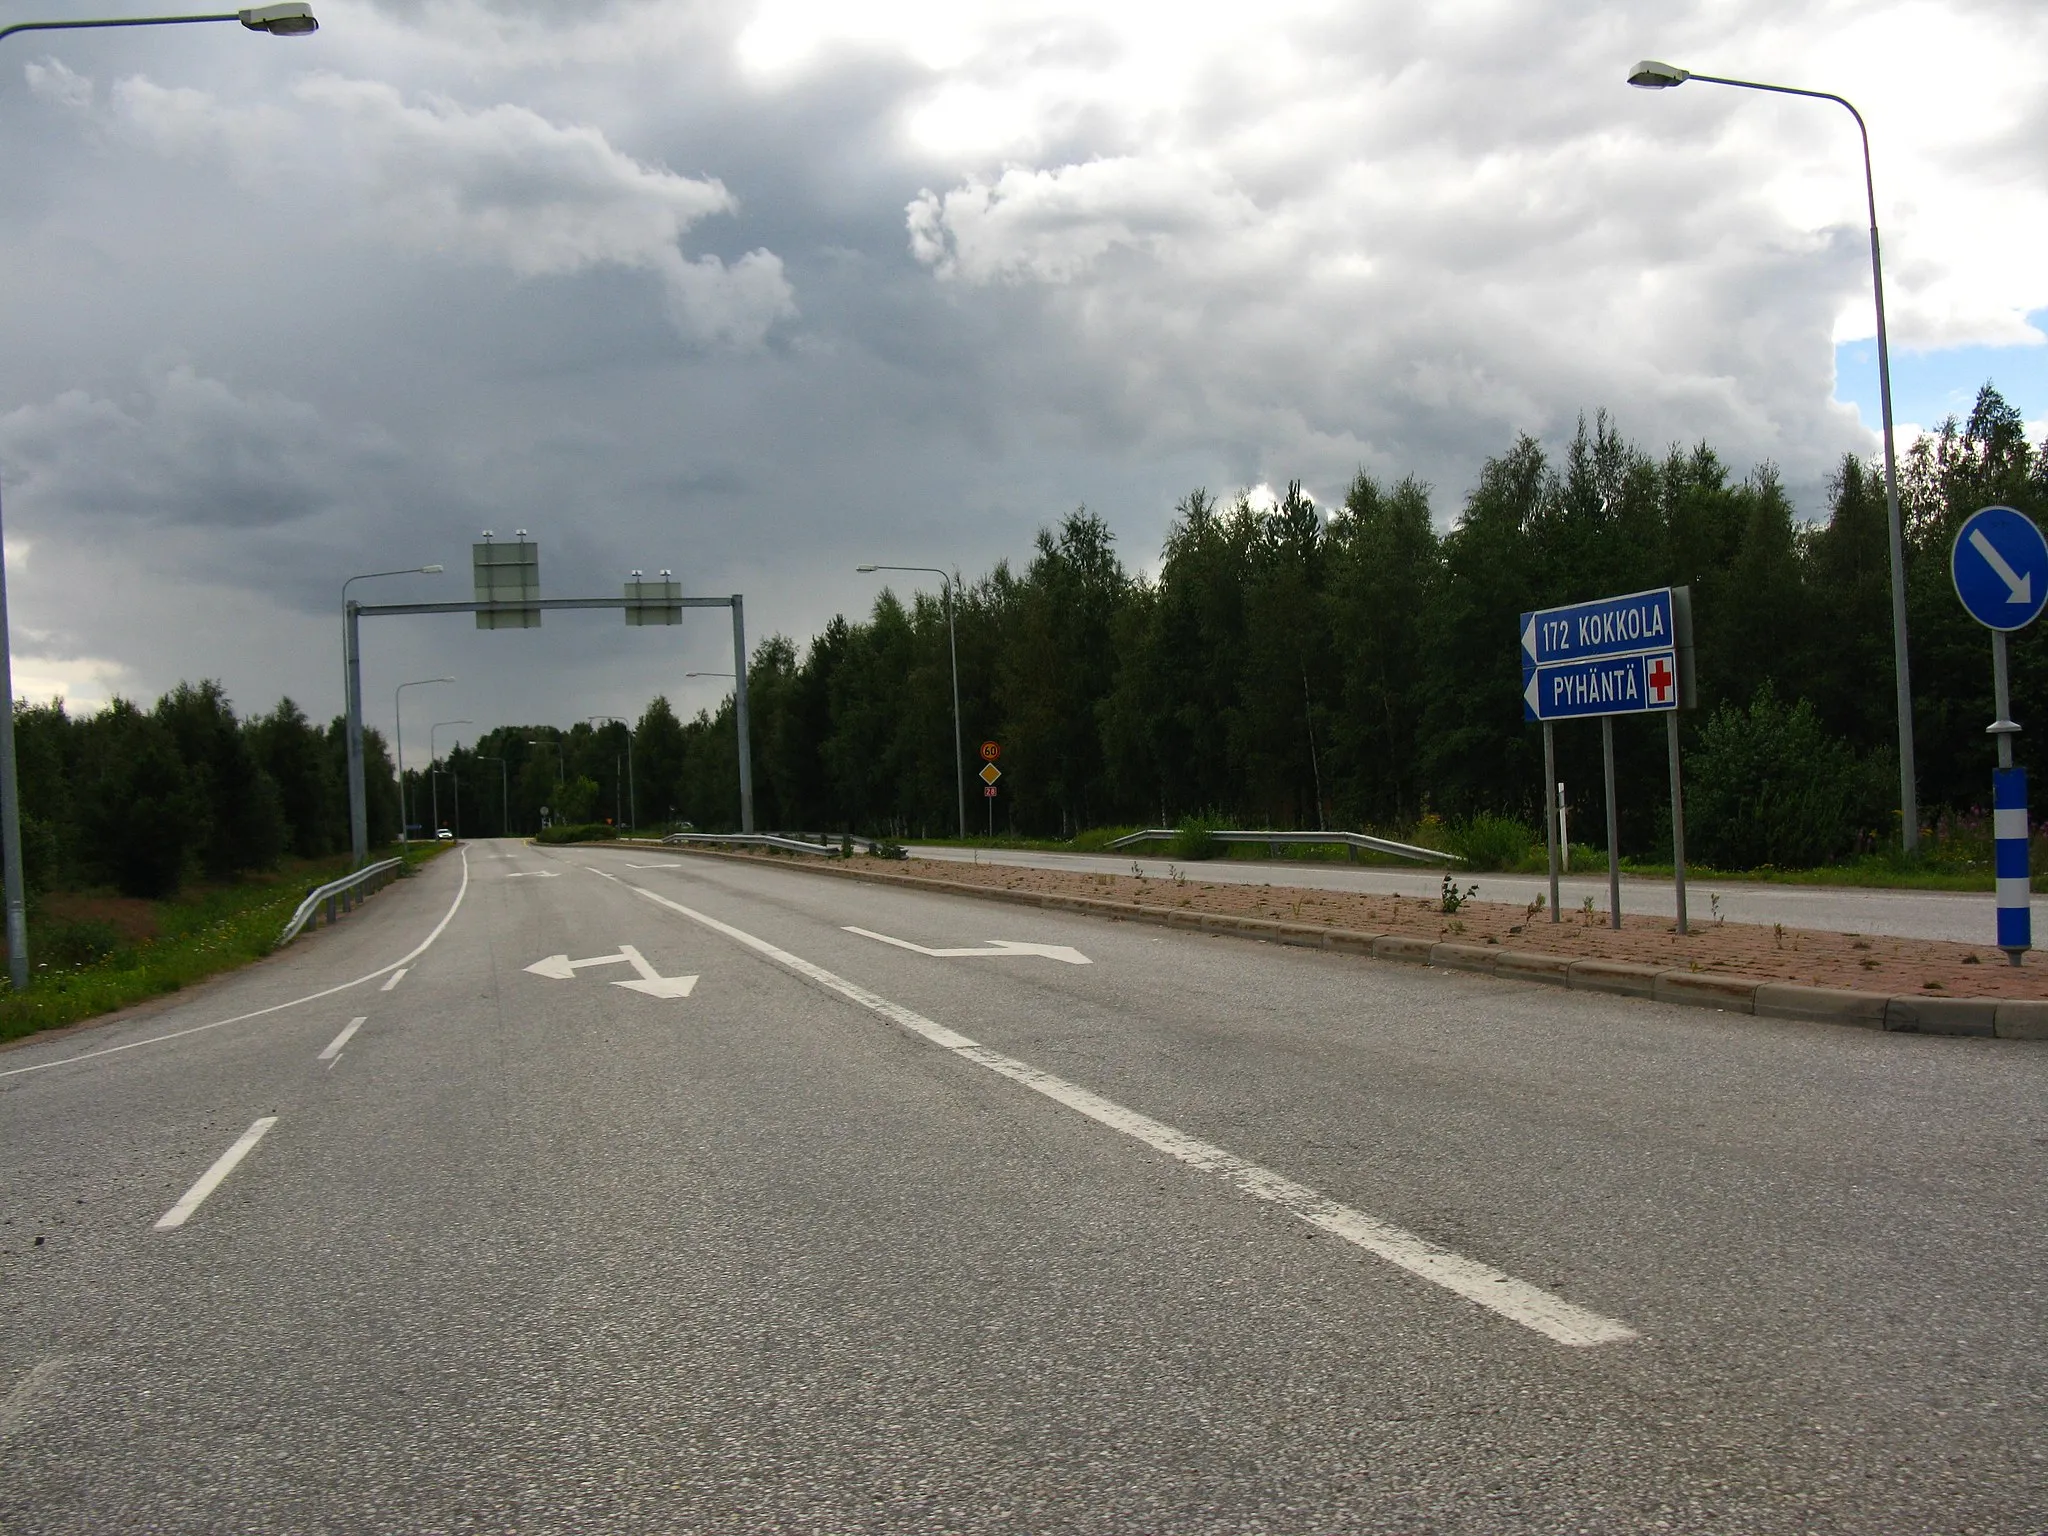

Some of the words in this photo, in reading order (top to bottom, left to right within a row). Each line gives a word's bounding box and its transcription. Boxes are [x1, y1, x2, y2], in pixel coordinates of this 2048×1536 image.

[1543, 620, 1570, 652] 172
[1579, 604, 1664, 646] KOKKOLA
[1554, 664, 1638, 706] PYHÄNTÄ
[985, 746, 996, 756] 60
